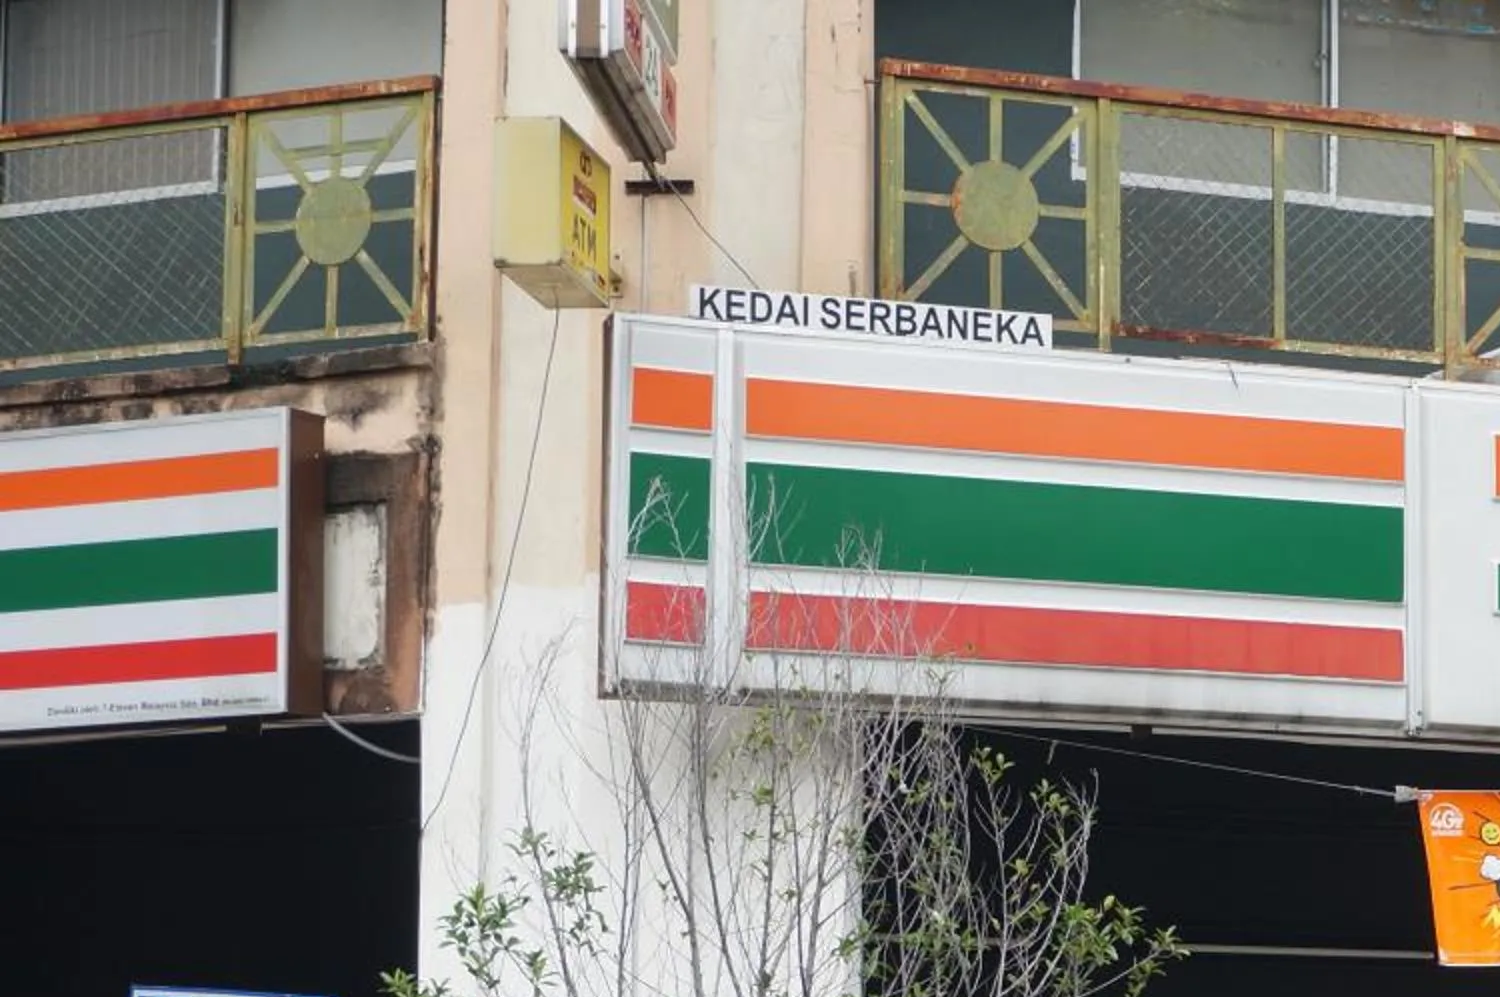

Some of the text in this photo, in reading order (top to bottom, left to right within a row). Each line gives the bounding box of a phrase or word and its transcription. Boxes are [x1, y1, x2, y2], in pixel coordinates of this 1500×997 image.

[572, 214, 597, 266] ATM
[699, 287, 1045, 347] KEDAI SERBANEKA
